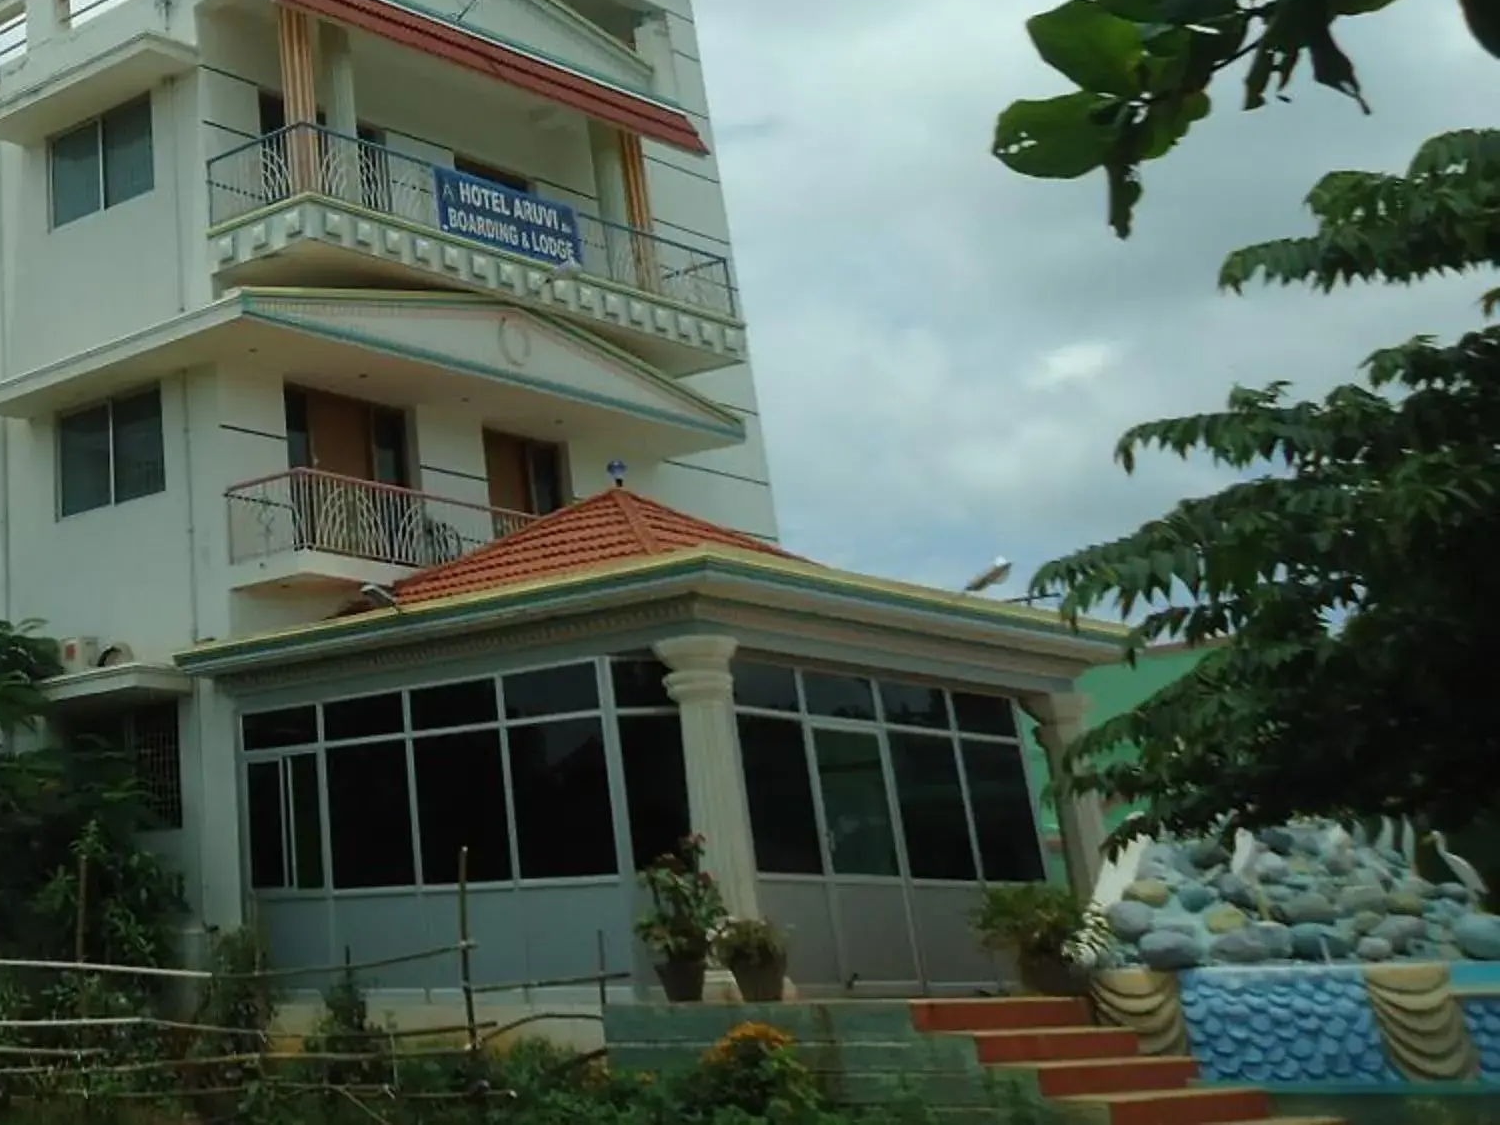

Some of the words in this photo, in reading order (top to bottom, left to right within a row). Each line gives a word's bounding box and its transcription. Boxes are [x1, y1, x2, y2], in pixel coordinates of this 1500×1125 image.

[447, 206, 519, 246] BOARDING
[521, 231, 531, 250] &
[458, 181, 511, 216] HOTEL
[513, 198, 559, 231] ARUVI
